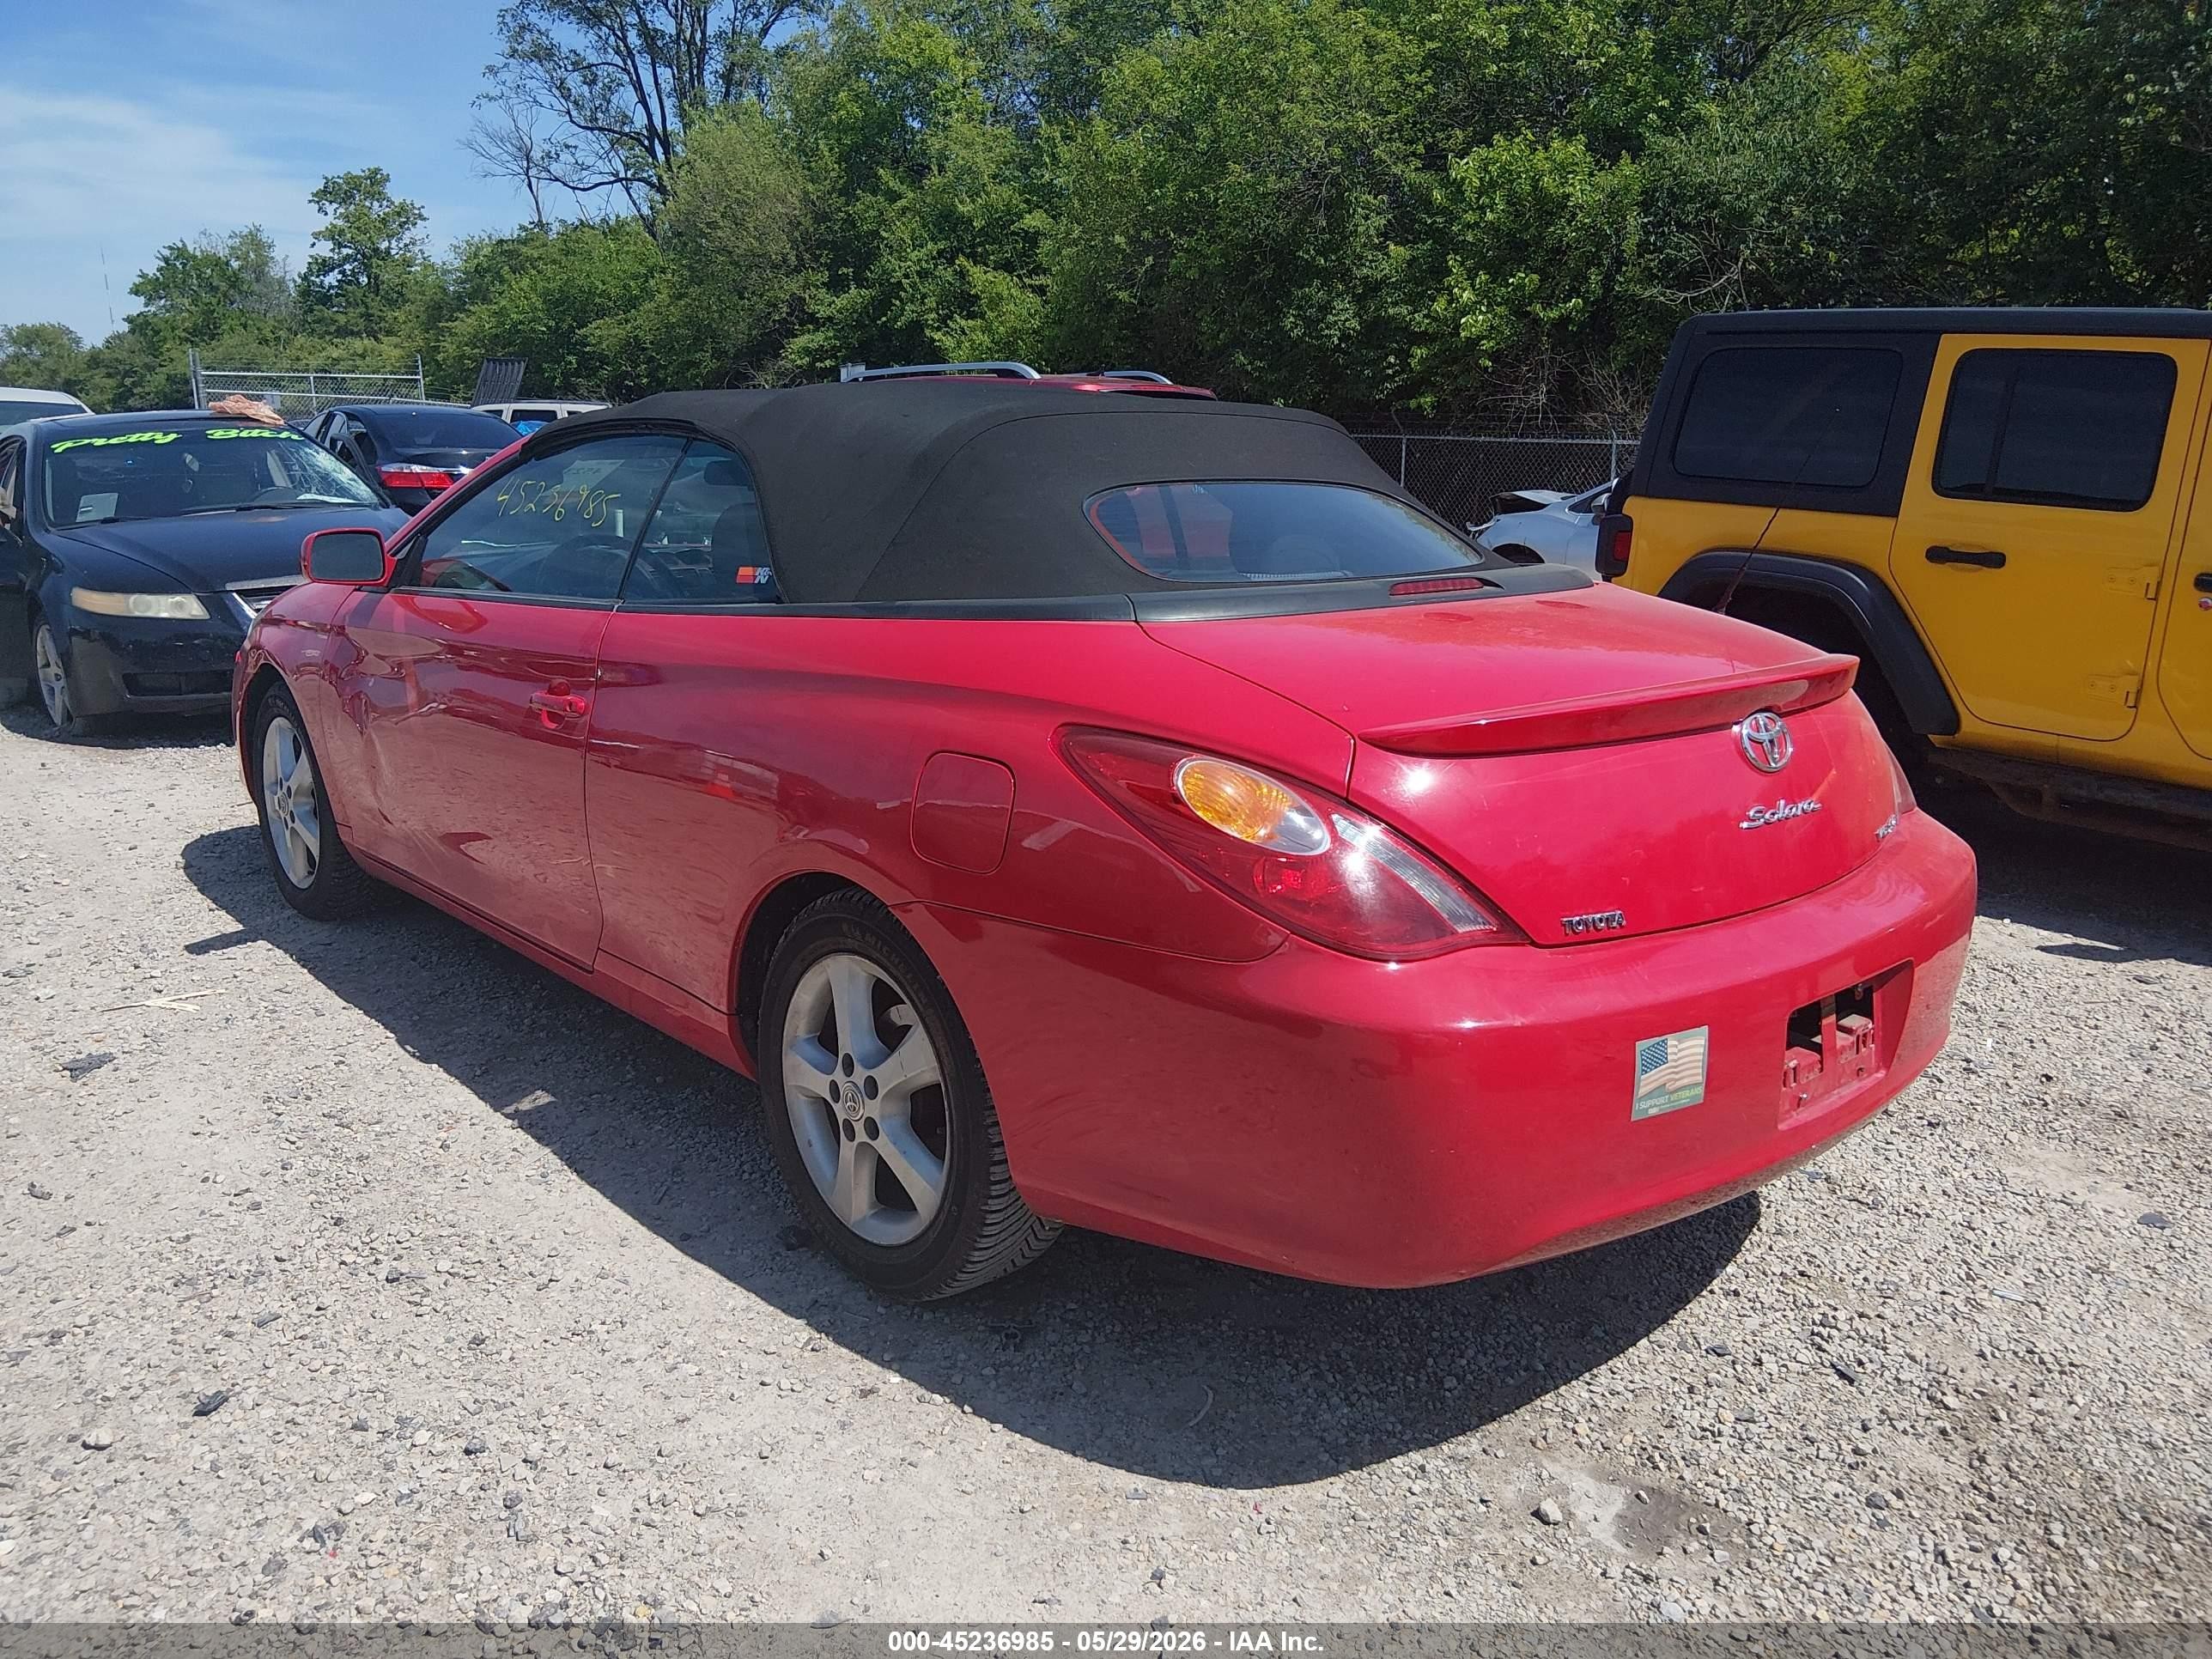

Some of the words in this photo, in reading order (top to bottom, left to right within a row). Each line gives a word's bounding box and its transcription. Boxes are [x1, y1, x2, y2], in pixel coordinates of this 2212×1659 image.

[50, 432, 183, 454] Pretty
[205, 428, 305, 441] Bitch
[497, 476, 621, 527] 45236985
[1739, 797, 1823, 830] Solara
[1559, 910, 1626, 935] TOYOTA
[1639, 1095, 1668, 1109] SUPPORT
[1670, 1086, 1702, 1100] VETERANS
